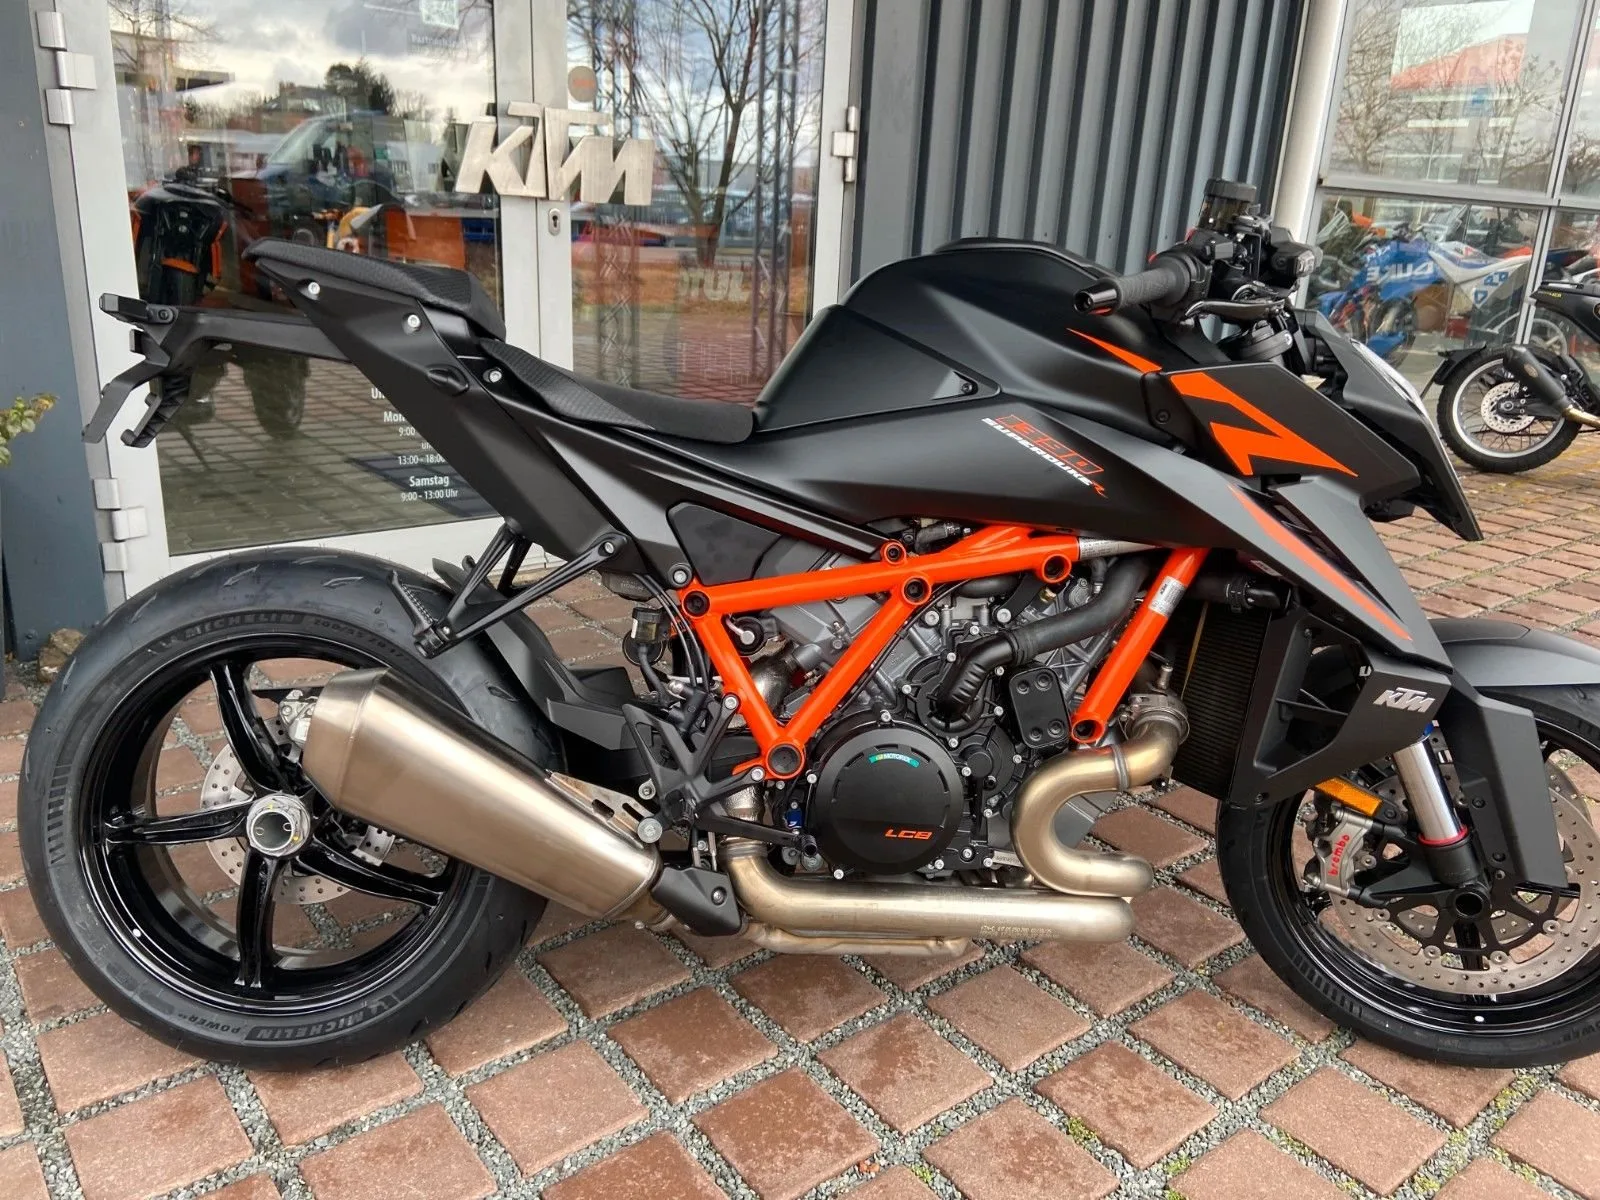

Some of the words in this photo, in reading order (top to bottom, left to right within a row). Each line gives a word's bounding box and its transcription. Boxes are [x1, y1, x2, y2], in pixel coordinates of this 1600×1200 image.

[454, 101, 657, 206] KTM
[399, 427, 415, 436] 9:00
[398, 455, 418, 465] 13:00
[409, 475, 450, 487] Samstag
[401, 492, 418, 501] 9:00
[424, 490, 444, 499] 13:00
[445, 488, 458, 498] Uhr
[184, 612, 296, 640] MICHELIN
[1373, 687, 1436, 713] KTM
[885, 829, 932, 839] LC8
[1327, 834, 1350, 876] brembo
[188, 1014, 242, 1035] POWER
[257, 1011, 365, 1040] MICHELIN
